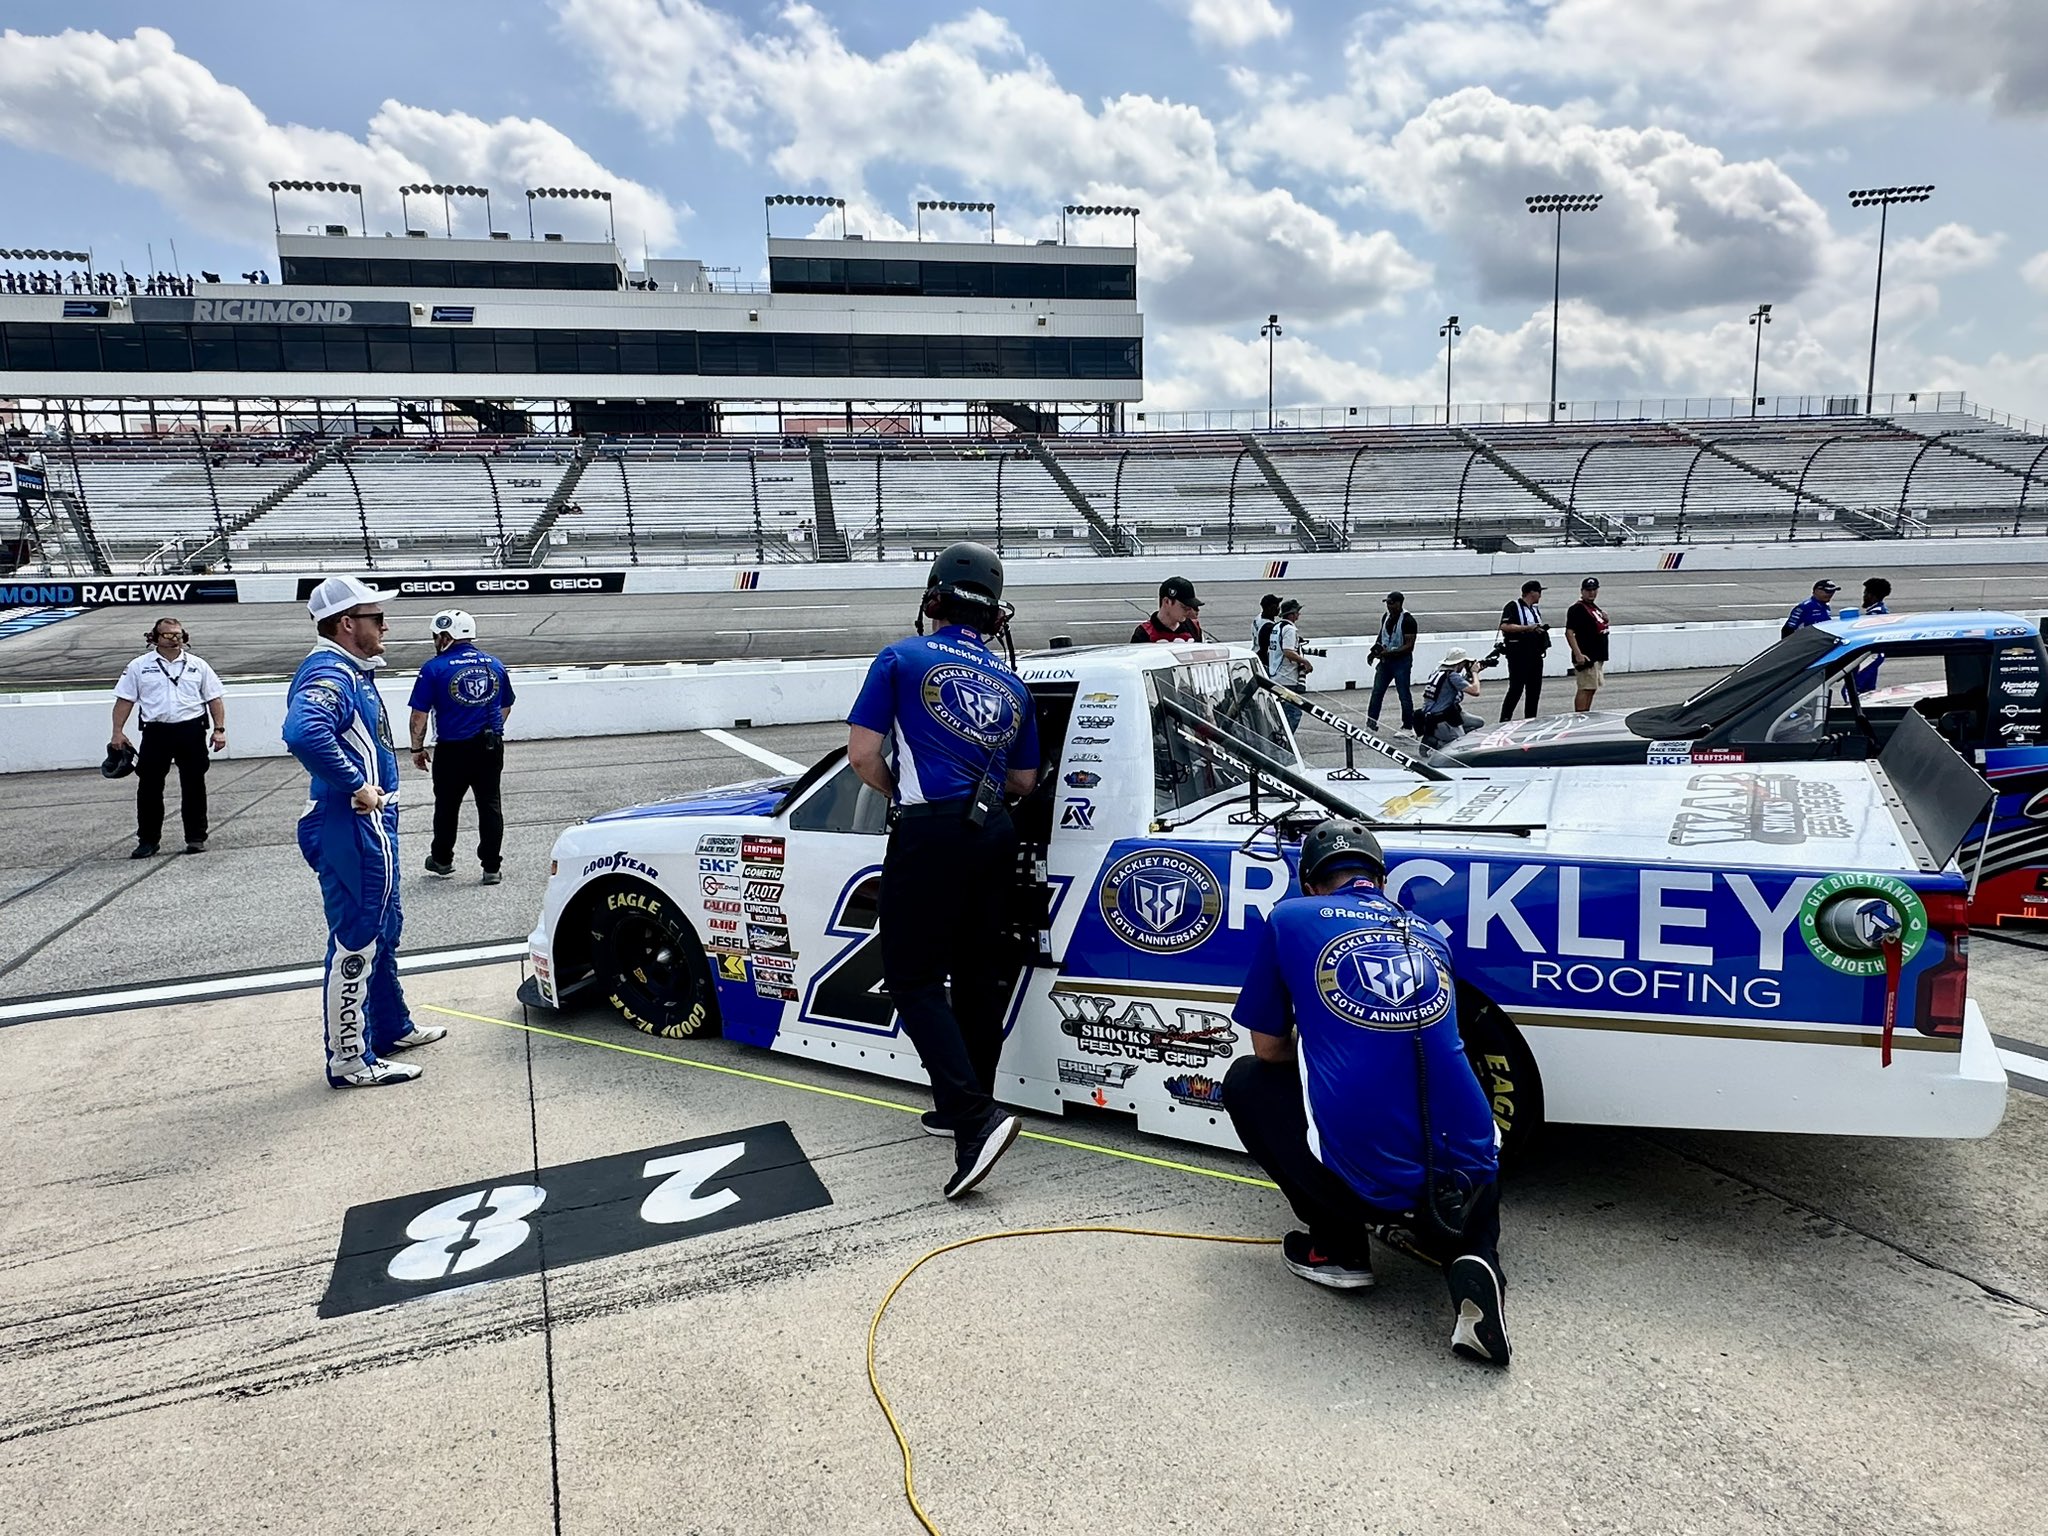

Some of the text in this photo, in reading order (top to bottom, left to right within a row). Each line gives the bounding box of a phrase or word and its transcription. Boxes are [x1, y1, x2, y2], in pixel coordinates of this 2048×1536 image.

[194, 301, 352, 322] RICHMOND
[82, 584, 191, 603] RACEWAY
[401, 581, 455, 593] GEICO
[476, 580, 529, 591] GEICO
[550, 578, 602, 590] GEICO
[932, 664, 974, 685] RACKLEY
[1023, 669, 1075, 681] DILLON
[934, 704, 961, 729] 50TH
[1310, 703, 1417, 768] CHEVROLET
[1648, 756, 1690, 765] SKF
[1693, 754, 1742, 762] CRAFTSMAN
[744, 844, 783, 855] CRAFTSMAN
[583, 851, 659, 879] GOODYEAR
[699, 858, 739, 873] SKF
[1111, 856, 1210, 891] RACKLEY ROOFING
[748, 883, 782, 899] KLOTZ
[1807, 873, 1918, 914] GET BIOETHANOL
[607, 892, 662, 915] EAGLE
[745, 904, 780, 915] LINCOLN
[1228, 850, 1812, 971] RCKLEY
[1110, 910, 1209, 946] 50TH ANNIVERSARY
[708, 935, 747, 949] JESEL
[1326, 934, 1383, 966] RACKLEY
[754, 955, 791, 969] tilton
[1809, 935, 1918, 974] GET BIOETHOL
[755, 968, 793, 984] KOOKS
[1532, 960, 1782, 1009] ROOFING
[1330, 990, 1448, 1022] 50TH ANNIVERSARY
[1081, 1025, 1151, 1047] SHOCKS
[1079, 1038, 1121, 1054] FEEL
[1125, 1044, 1160, 1061] THE
[1164, 1050, 1207, 1067] GRIP
[1058, 1061, 1106, 1076] EAGLE
